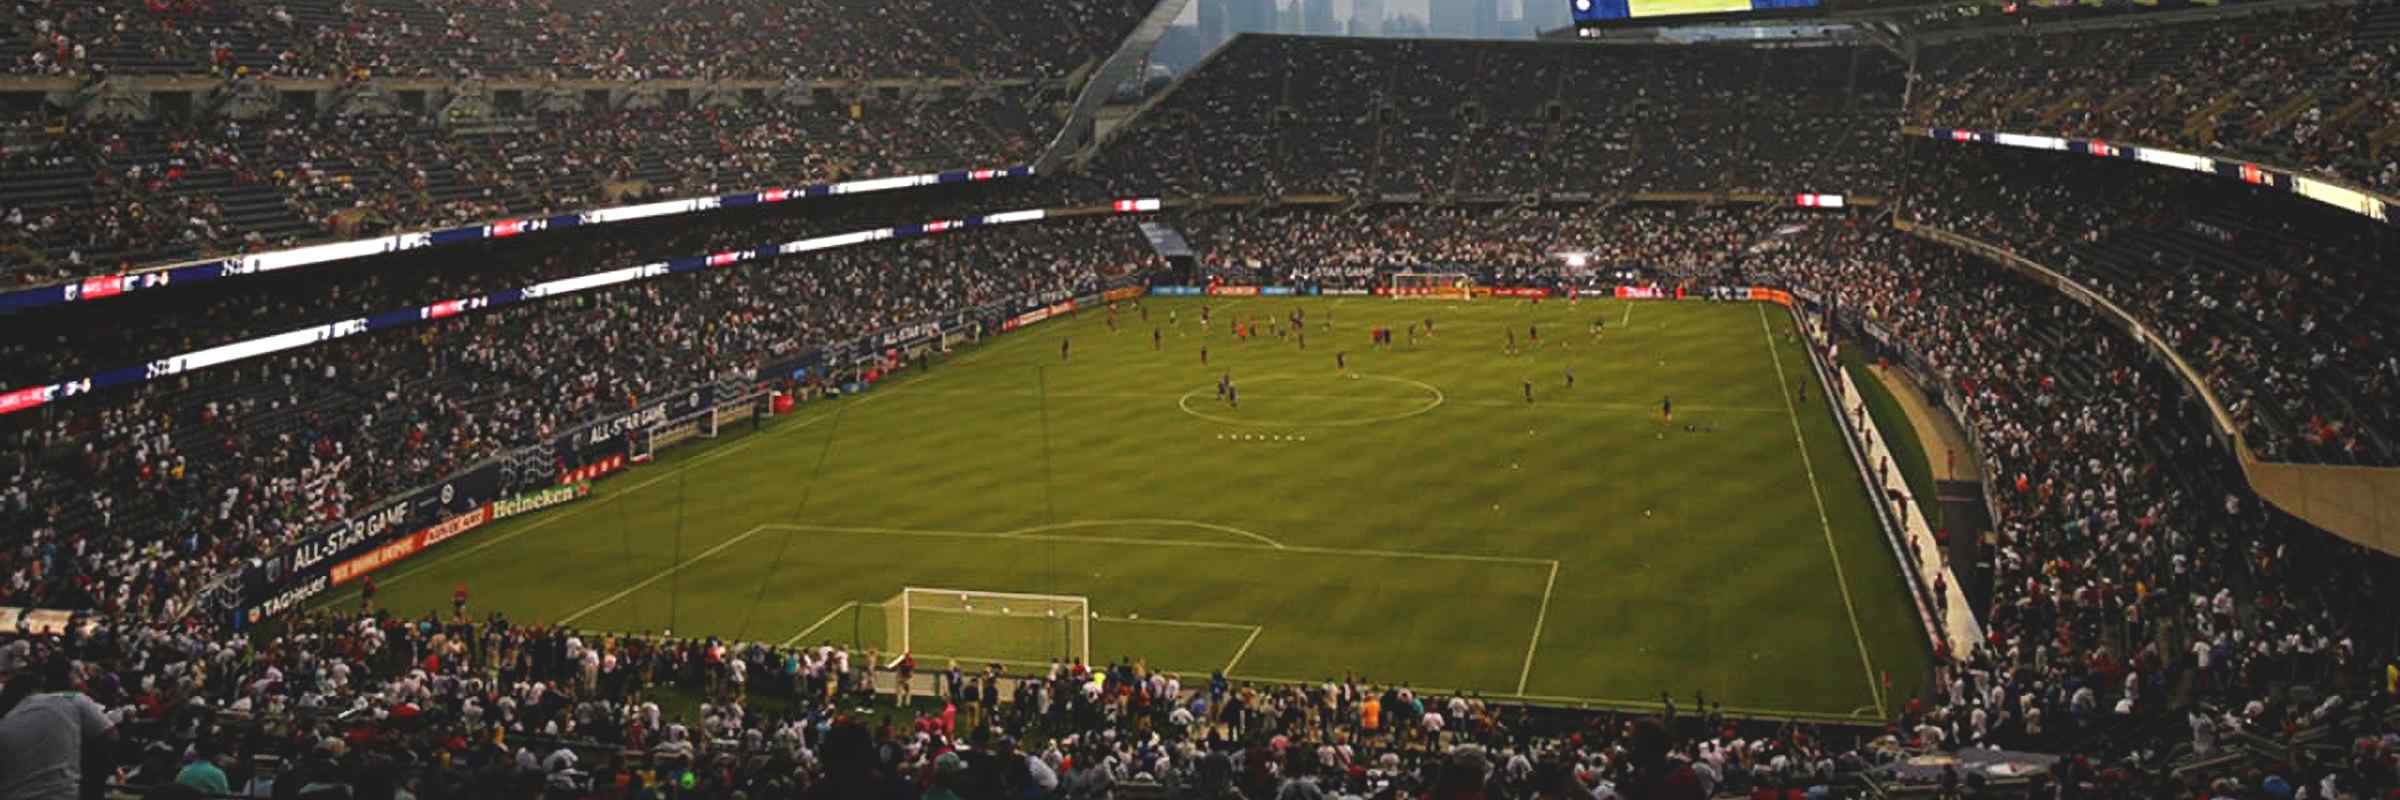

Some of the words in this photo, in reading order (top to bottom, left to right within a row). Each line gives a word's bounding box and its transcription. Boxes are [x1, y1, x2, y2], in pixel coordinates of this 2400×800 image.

[493, 487, 573, 519] Heineken
[293, 519, 366, 573] ALL-STAR
[367, 501, 409, 537] GAME
